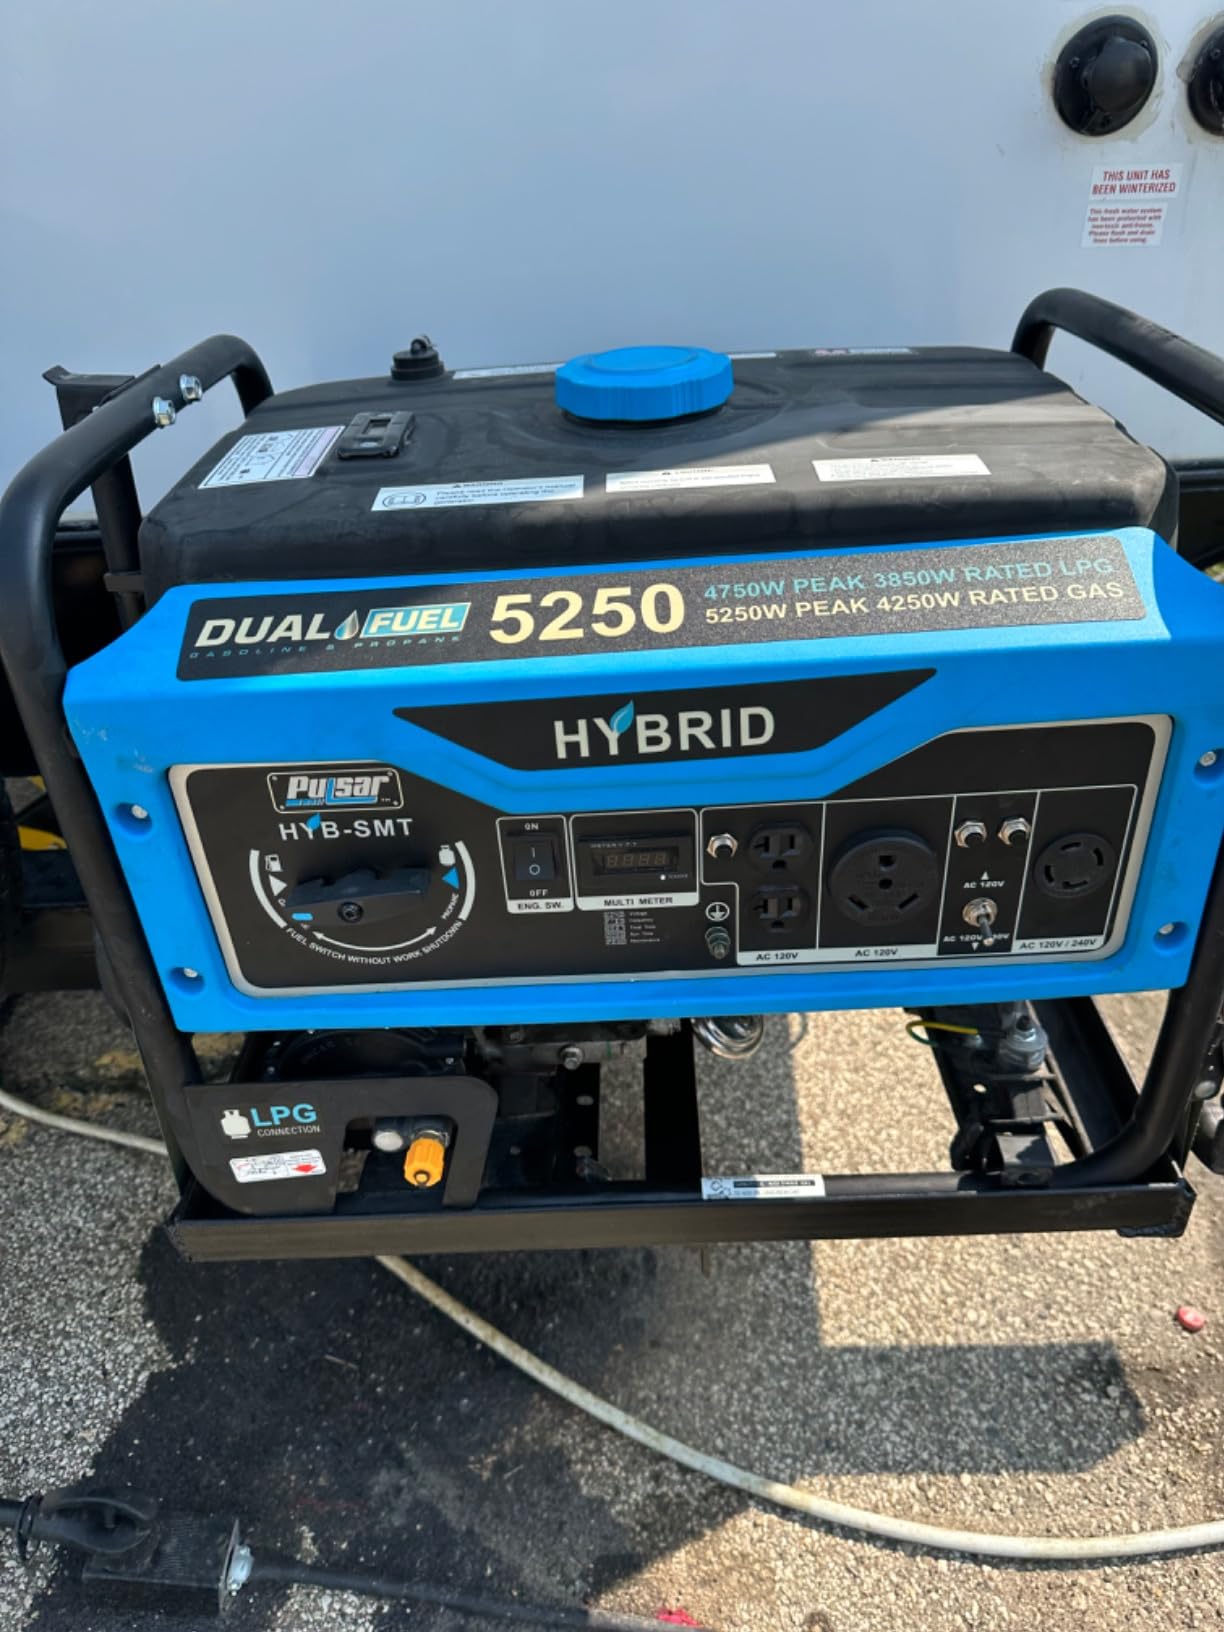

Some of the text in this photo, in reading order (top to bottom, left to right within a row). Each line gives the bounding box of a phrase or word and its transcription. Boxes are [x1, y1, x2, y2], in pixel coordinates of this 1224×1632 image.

[1103, 168, 1170, 182] THIS UNIT HAS
[1092, 182, 1176, 195] BEEN WINTERIZED
[704, 558, 1114, 600] 4750W PEAK 3850W RATED LPG
[706, 582, 1124, 624] 5250W PEAK 4250W RATED GAS
[488, 582, 685, 644] 5250
[195, 606, 462, 648] DUAL FUEL
[189, 645, 308, 658] GASOLINE
[353, 636, 462, 648] PROPANE
[554, 706, 776, 759] HYBRID
[278, 818, 413, 841] HYB-SMT
[524, 822, 540, 830] ON
[980, 880, 1005, 888] 120V
[529, 888, 548, 897] OFF
[518, 902, 564, 910] ENG. SW.
[604, 896, 673, 906] MULTI METER
[286, 920, 463, 965] FUEL SWITCH WITHOUT WORK SHUTDOWN
[1020, 942, 1036, 950] AC
[756, 952, 799, 961] AC 120V
[854, 948, 898, 958] AC 120V
[250, 1103, 317, 1127] LPG
[257, 1124, 320, 1137] CONNECTION
